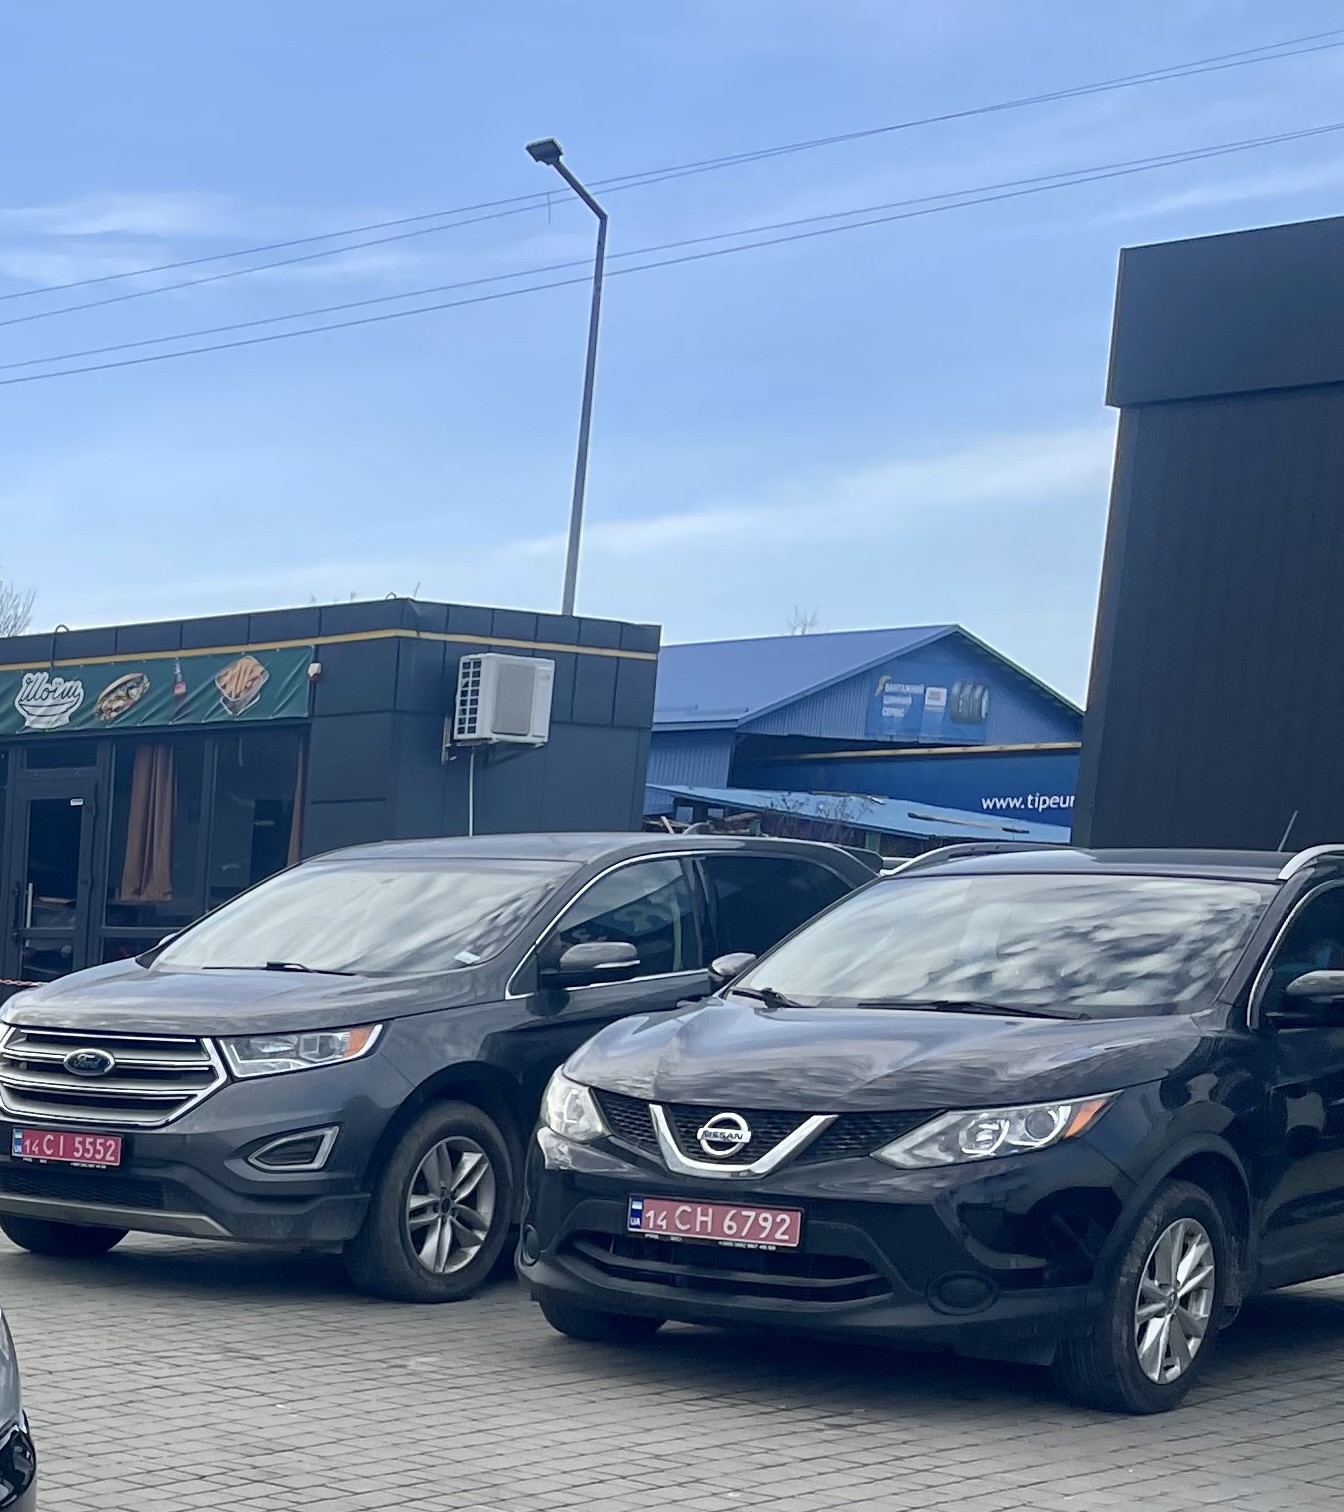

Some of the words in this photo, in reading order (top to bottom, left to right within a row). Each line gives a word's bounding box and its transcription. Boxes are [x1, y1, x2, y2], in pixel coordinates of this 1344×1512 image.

[702, 1130, 743, 1141] NISSAN
[24, 1139, 39, 1154] 14
[73, 1136, 115, 1161] 5552
[645, 1210, 667, 1230] 14
[675, 1205, 712, 1232] CH
[723, 1209, 791, 1240] 6792
